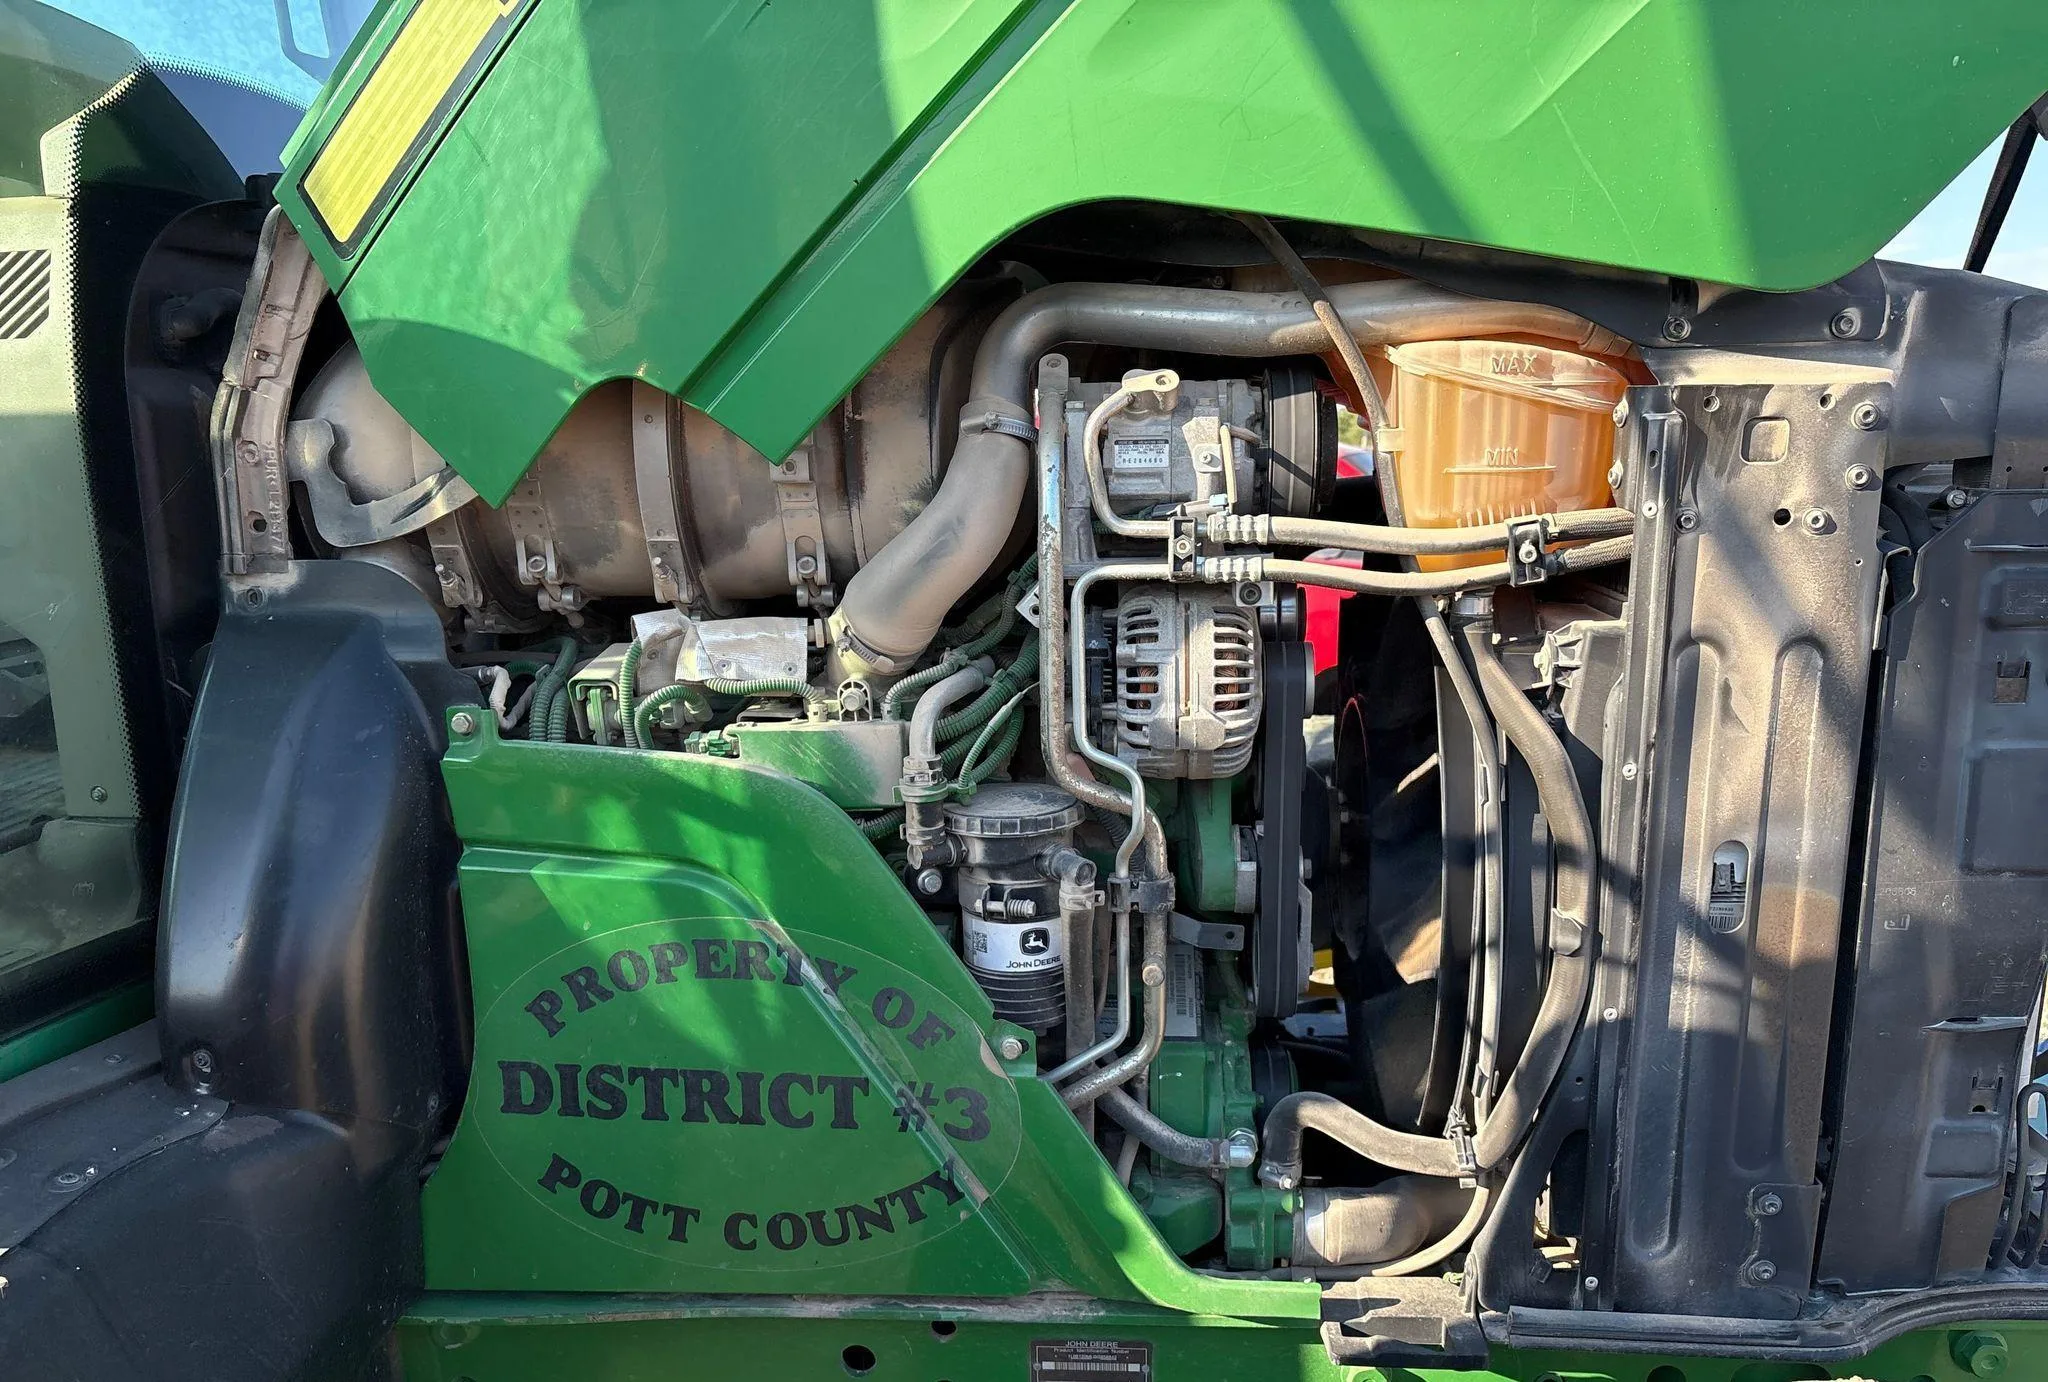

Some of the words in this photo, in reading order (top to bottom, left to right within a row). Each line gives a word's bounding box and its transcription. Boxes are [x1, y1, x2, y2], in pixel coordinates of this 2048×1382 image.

[1490, 354, 1538, 374] MAX
[1484, 447, 1520, 467] MIN
[1006, 960, 1032, 969] JOHN
[1033, 954, 1062, 967] DEERE
[524, 937, 859, 1038] PROPERTY
[871, 986, 956, 1051] OF
[498, 1060, 869, 1130] DISTRICT
[892, 1080, 992, 1143] #3
[537, 1153, 700, 1243] POTT
[723, 1157, 966, 1252] COUNTY
[1065, 1340, 1088, 1348] JOHN
